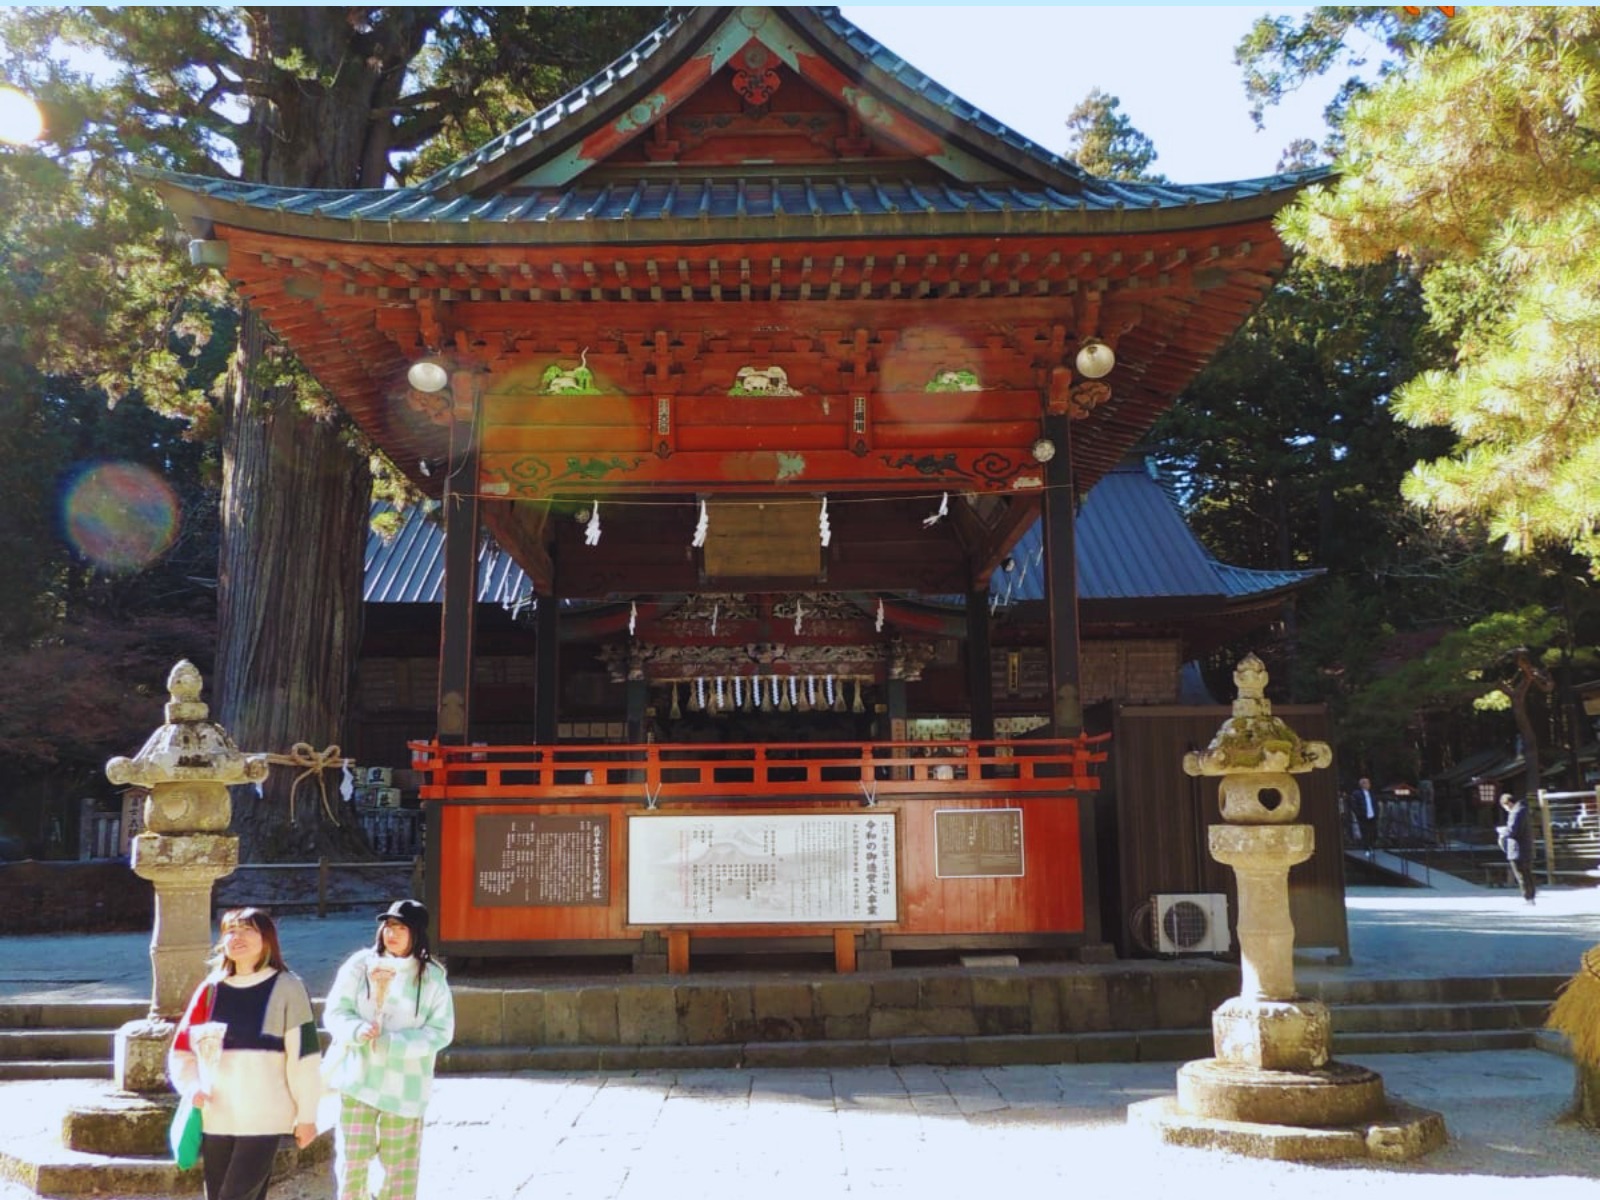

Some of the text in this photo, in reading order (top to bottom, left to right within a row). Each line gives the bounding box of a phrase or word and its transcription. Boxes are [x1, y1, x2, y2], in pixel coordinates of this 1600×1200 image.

[866, 820, 878, 915] 令和の御造営大事業
